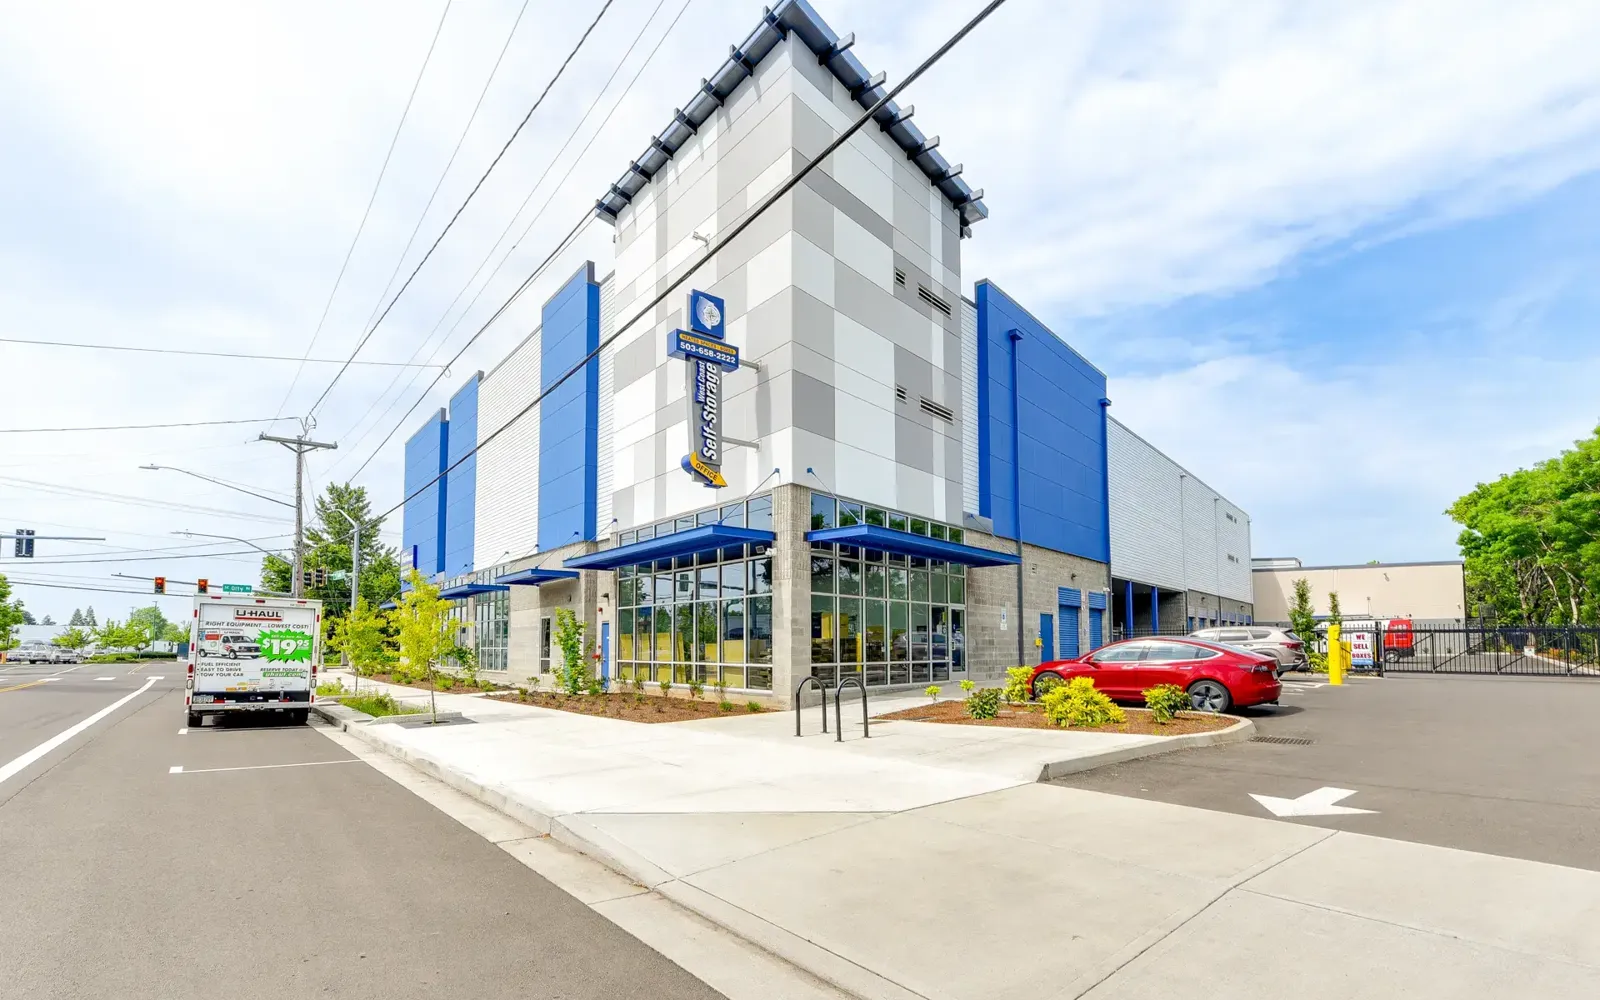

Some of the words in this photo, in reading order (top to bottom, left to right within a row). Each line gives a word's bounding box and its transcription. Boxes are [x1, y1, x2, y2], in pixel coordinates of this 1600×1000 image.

[680, 341, 736, 364] 503-658-2222
[697, 360, 705, 383] Coast
[697, 383, 705, 402] West
[702, 362, 720, 460] Self-Storage
[695, 462, 718, 481] OFFICE
[236, 609, 282, 618] U-HAUL
